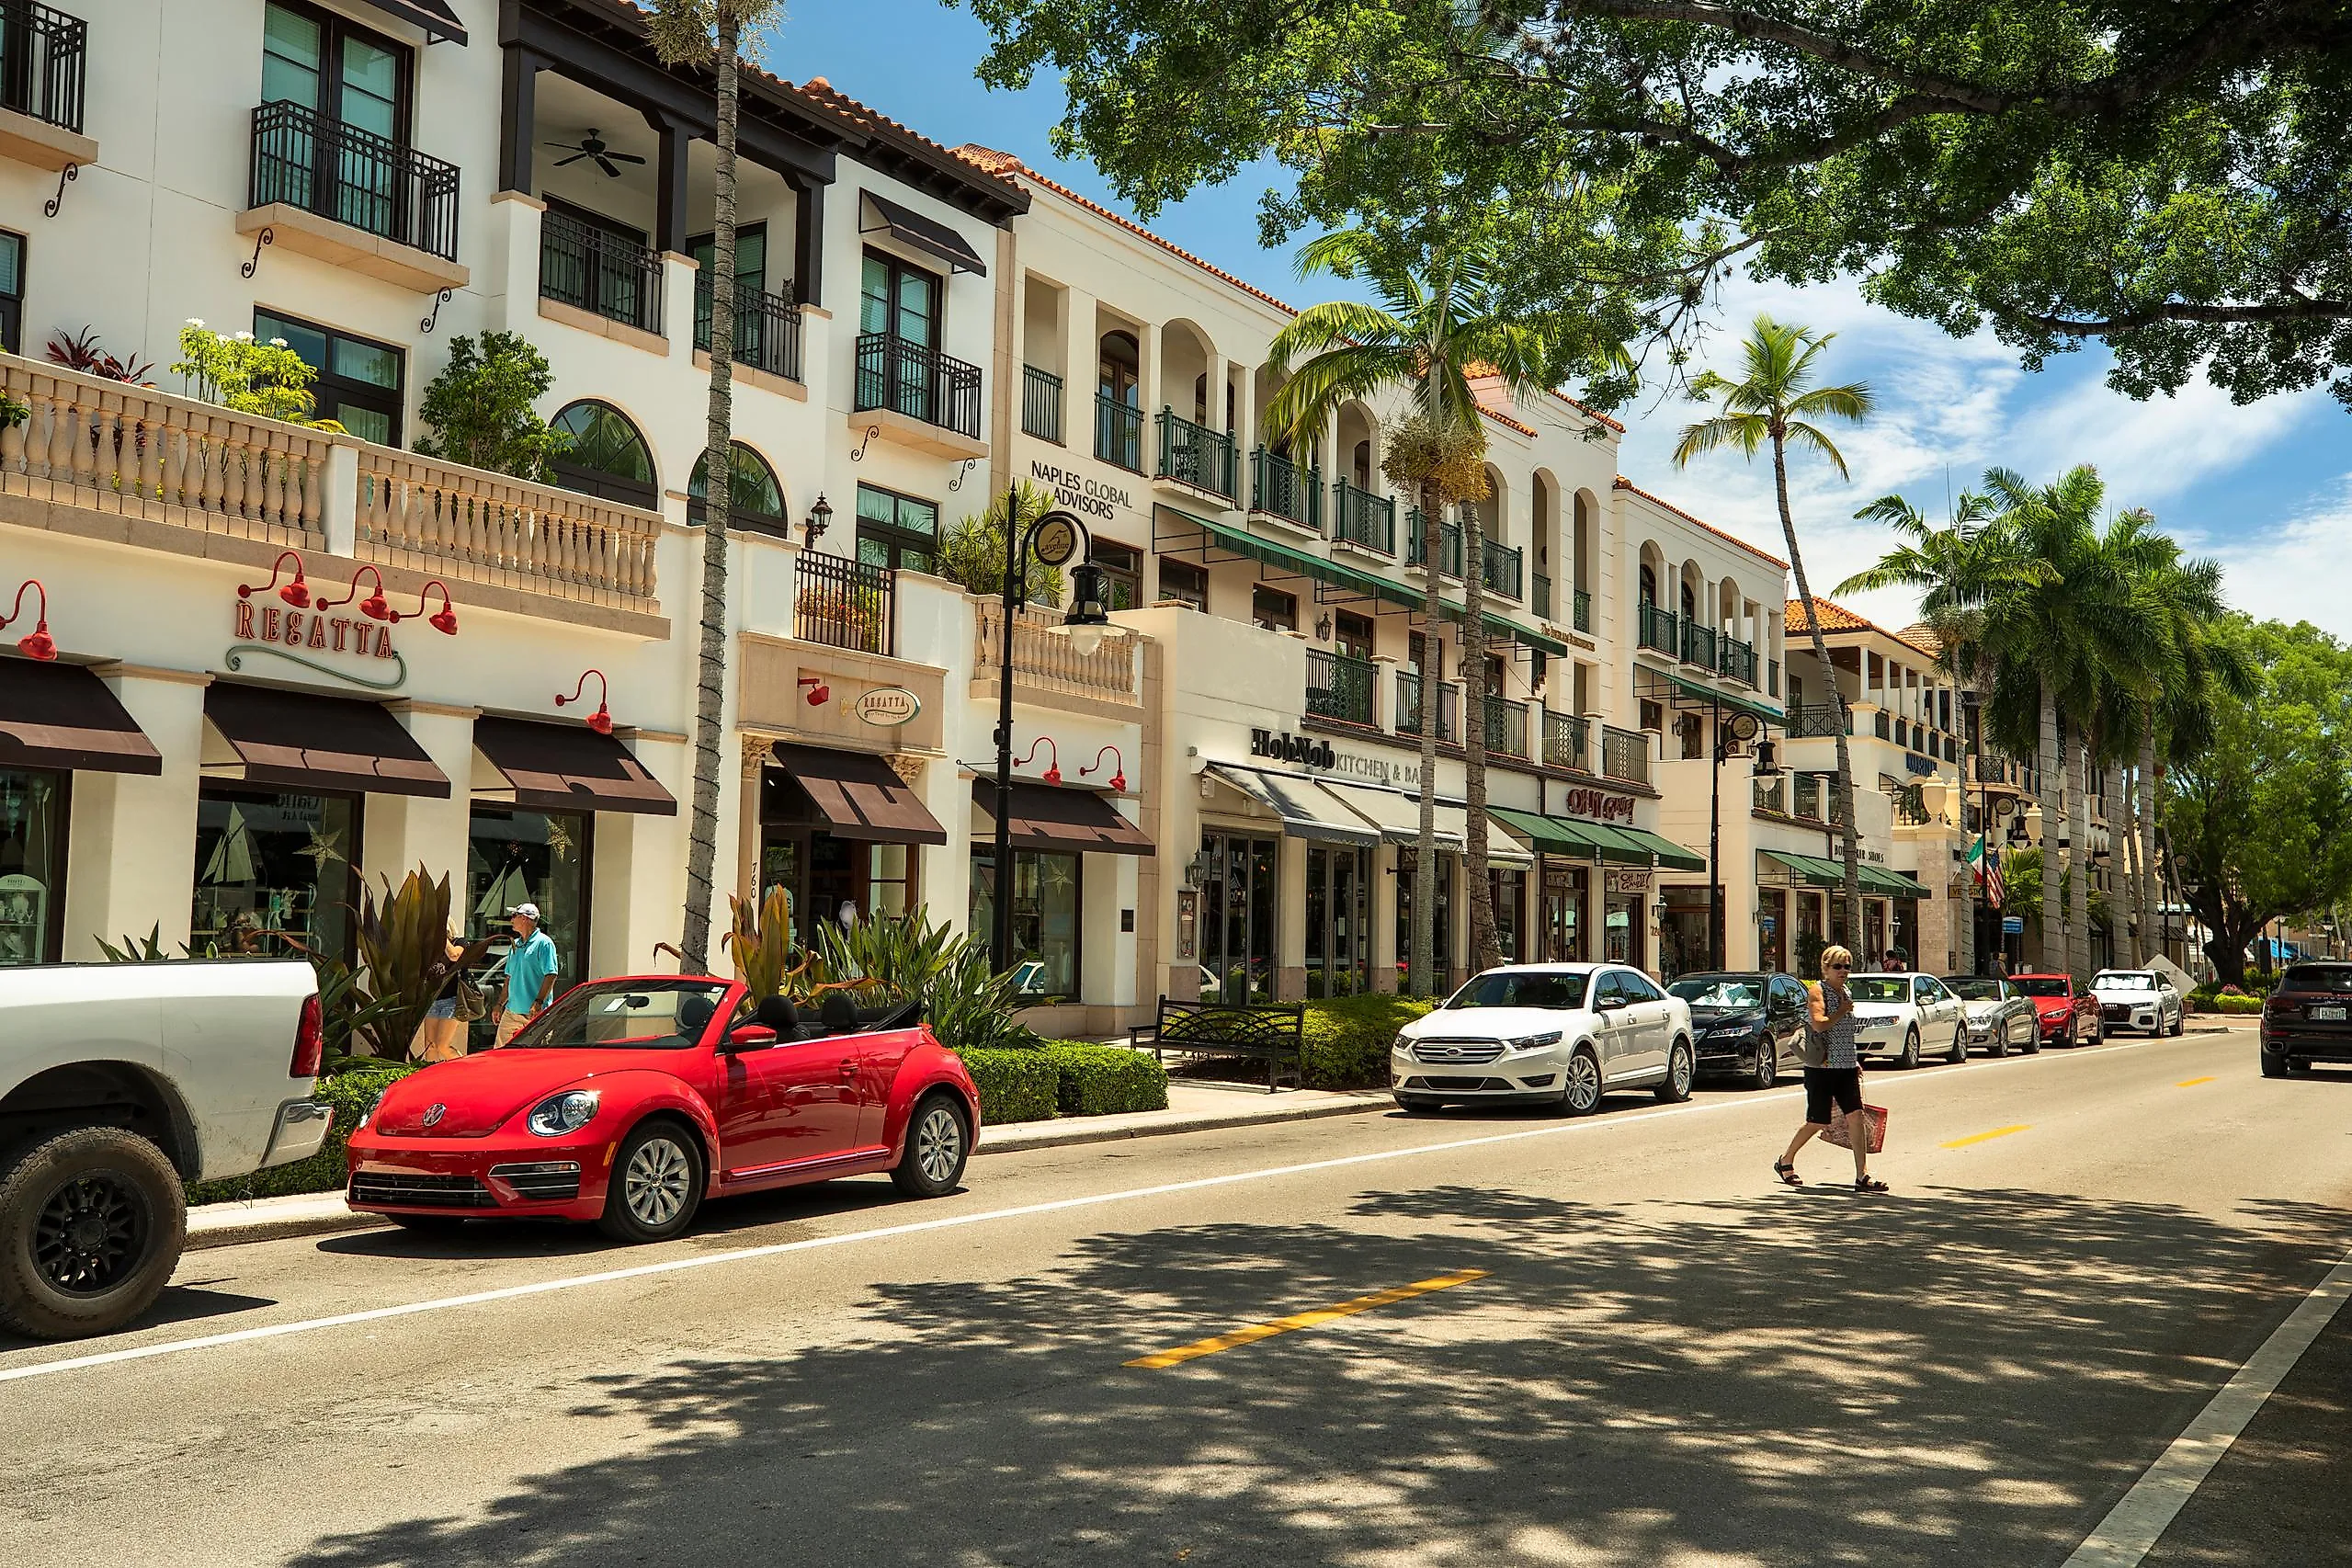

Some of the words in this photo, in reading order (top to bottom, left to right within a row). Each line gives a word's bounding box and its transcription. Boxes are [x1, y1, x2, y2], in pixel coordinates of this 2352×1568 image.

[1031, 460, 1081, 491] NAPLES
[1085, 479, 1133, 508] GLOBAL
[1054, 487, 1114, 520] ADVISORS
[235, 600, 393, 658] REGATTA
[864, 697, 905, 708] REGATTA
[1251, 728, 1335, 771] HobNob
[1335, 753, 1389, 779] KITCHEN
[1392, 764, 1401, 781] &
[1404, 766, 1422, 784] BA
[1620, 872, 1633, 882] OH
[1637, 873, 1647, 884] MY
